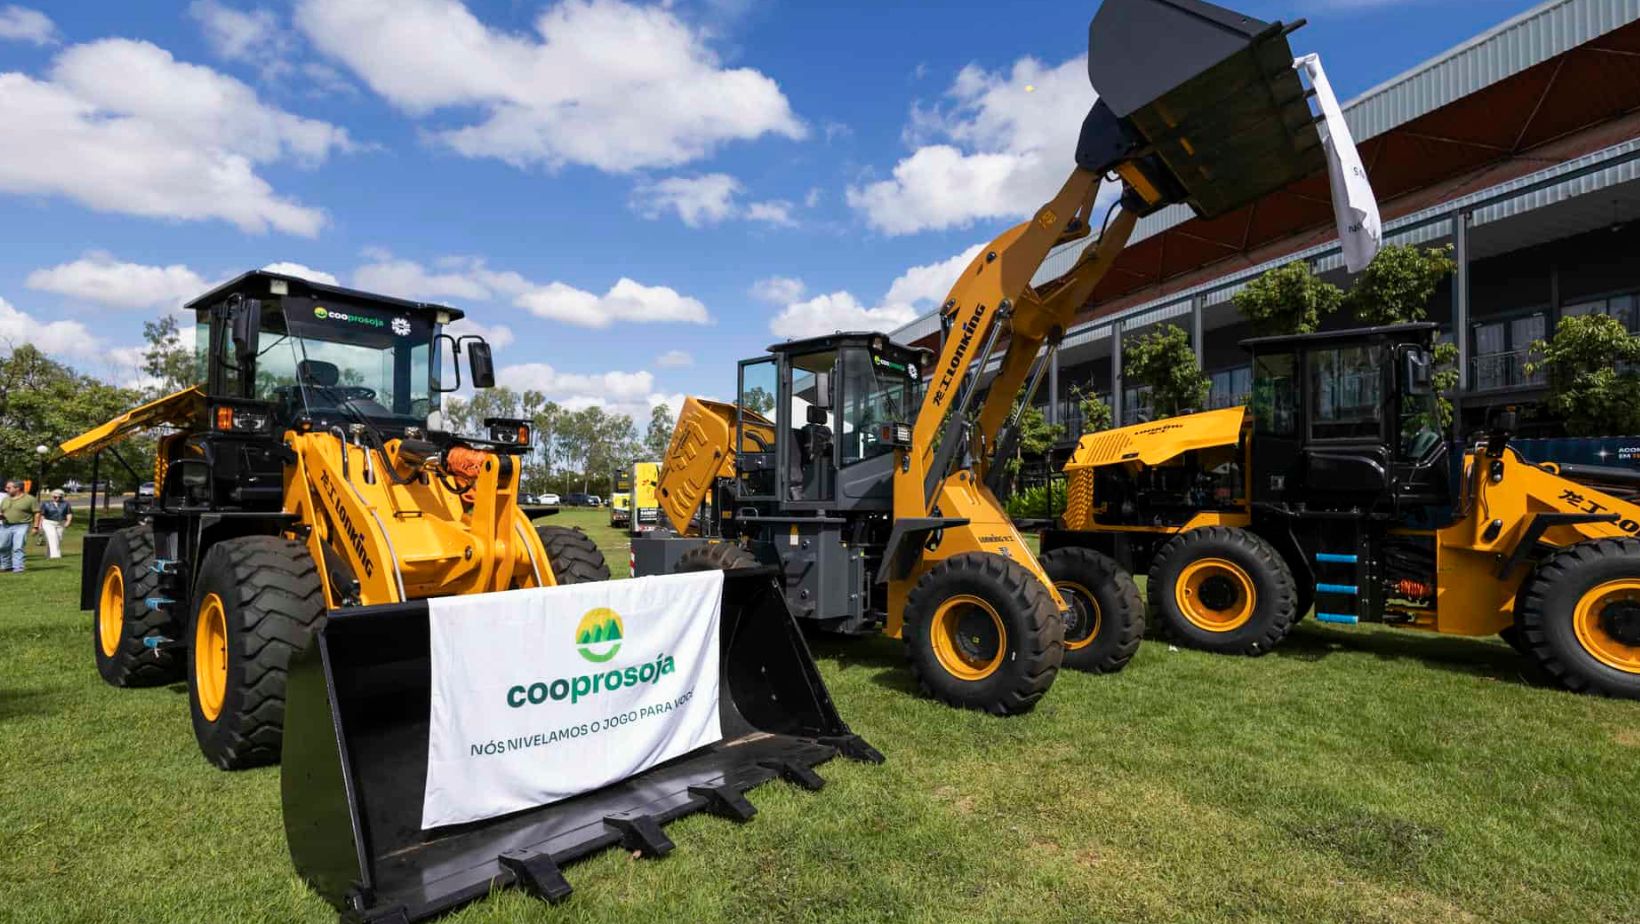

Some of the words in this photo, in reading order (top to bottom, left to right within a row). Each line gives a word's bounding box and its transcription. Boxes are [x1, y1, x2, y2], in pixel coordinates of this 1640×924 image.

[328, 311, 384, 327] cooprosoja
[507, 653, 676, 708] cooprosoja
[471, 740, 505, 756] NÓS
[507, 724, 588, 751] NIVELAMOS
[590, 721, 600, 733] O
[603, 711, 638, 730] JOGO
[640, 701, 673, 720] PARA
